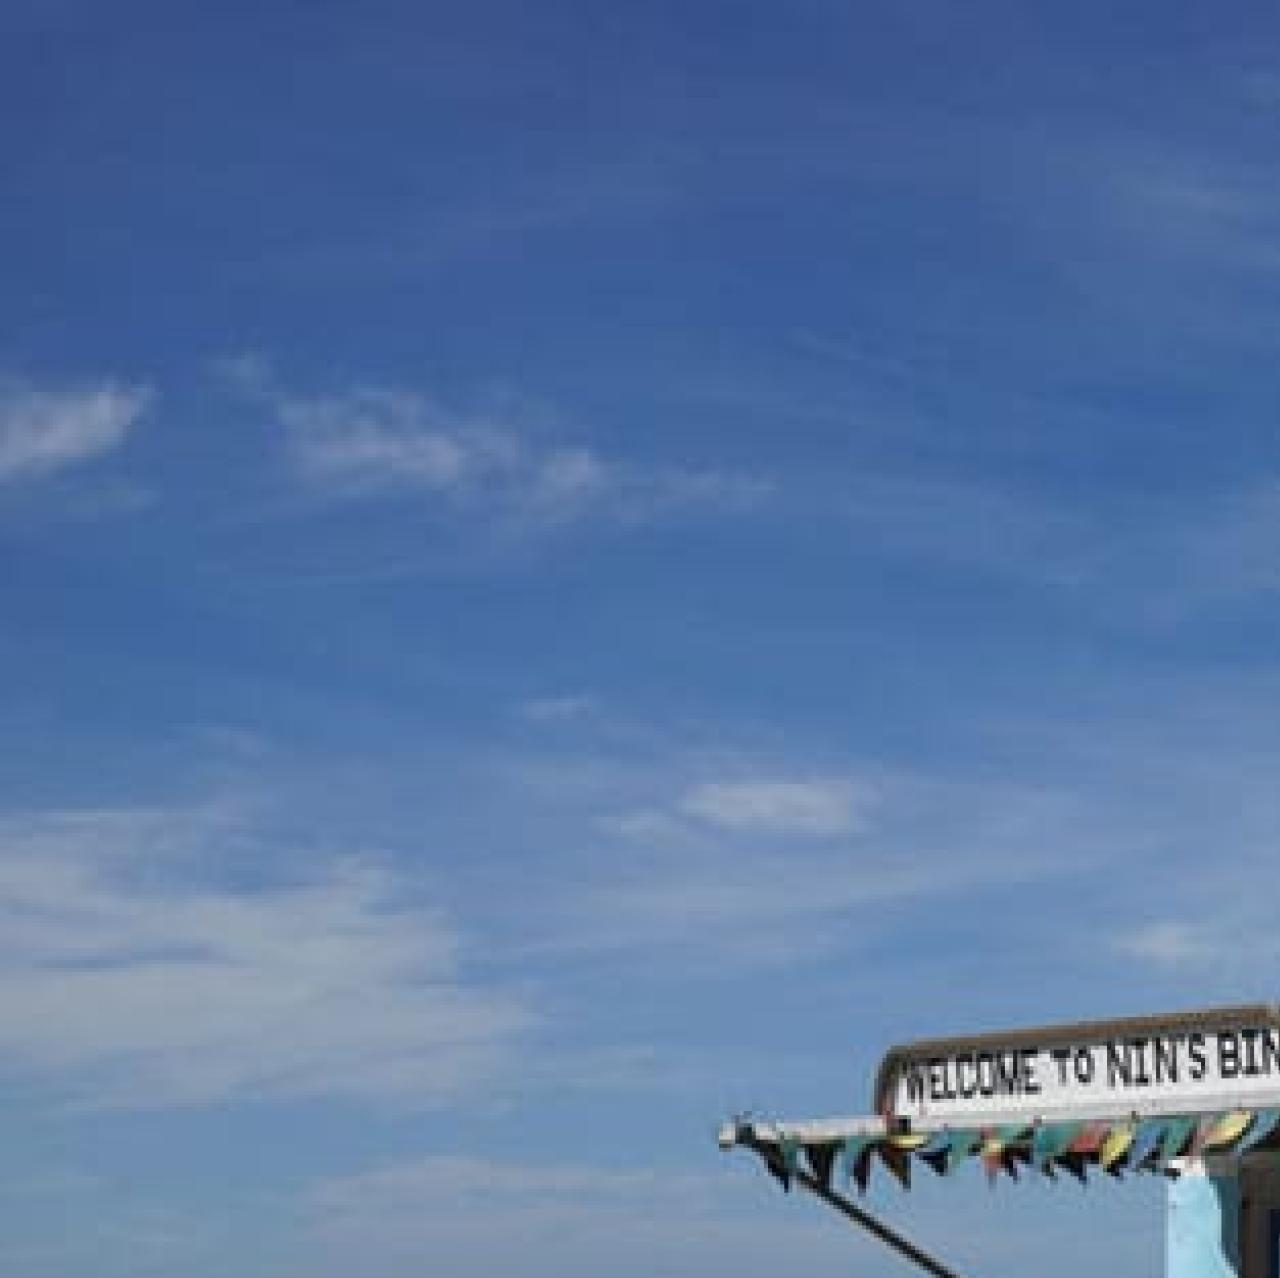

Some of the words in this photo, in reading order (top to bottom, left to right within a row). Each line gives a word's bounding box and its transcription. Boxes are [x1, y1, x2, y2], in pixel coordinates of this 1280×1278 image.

[904, 1048, 1041, 1103] WELCOME
[1053, 1046, 1092, 1084] TO
[1106, 1033, 1207, 1087] NIN'S
